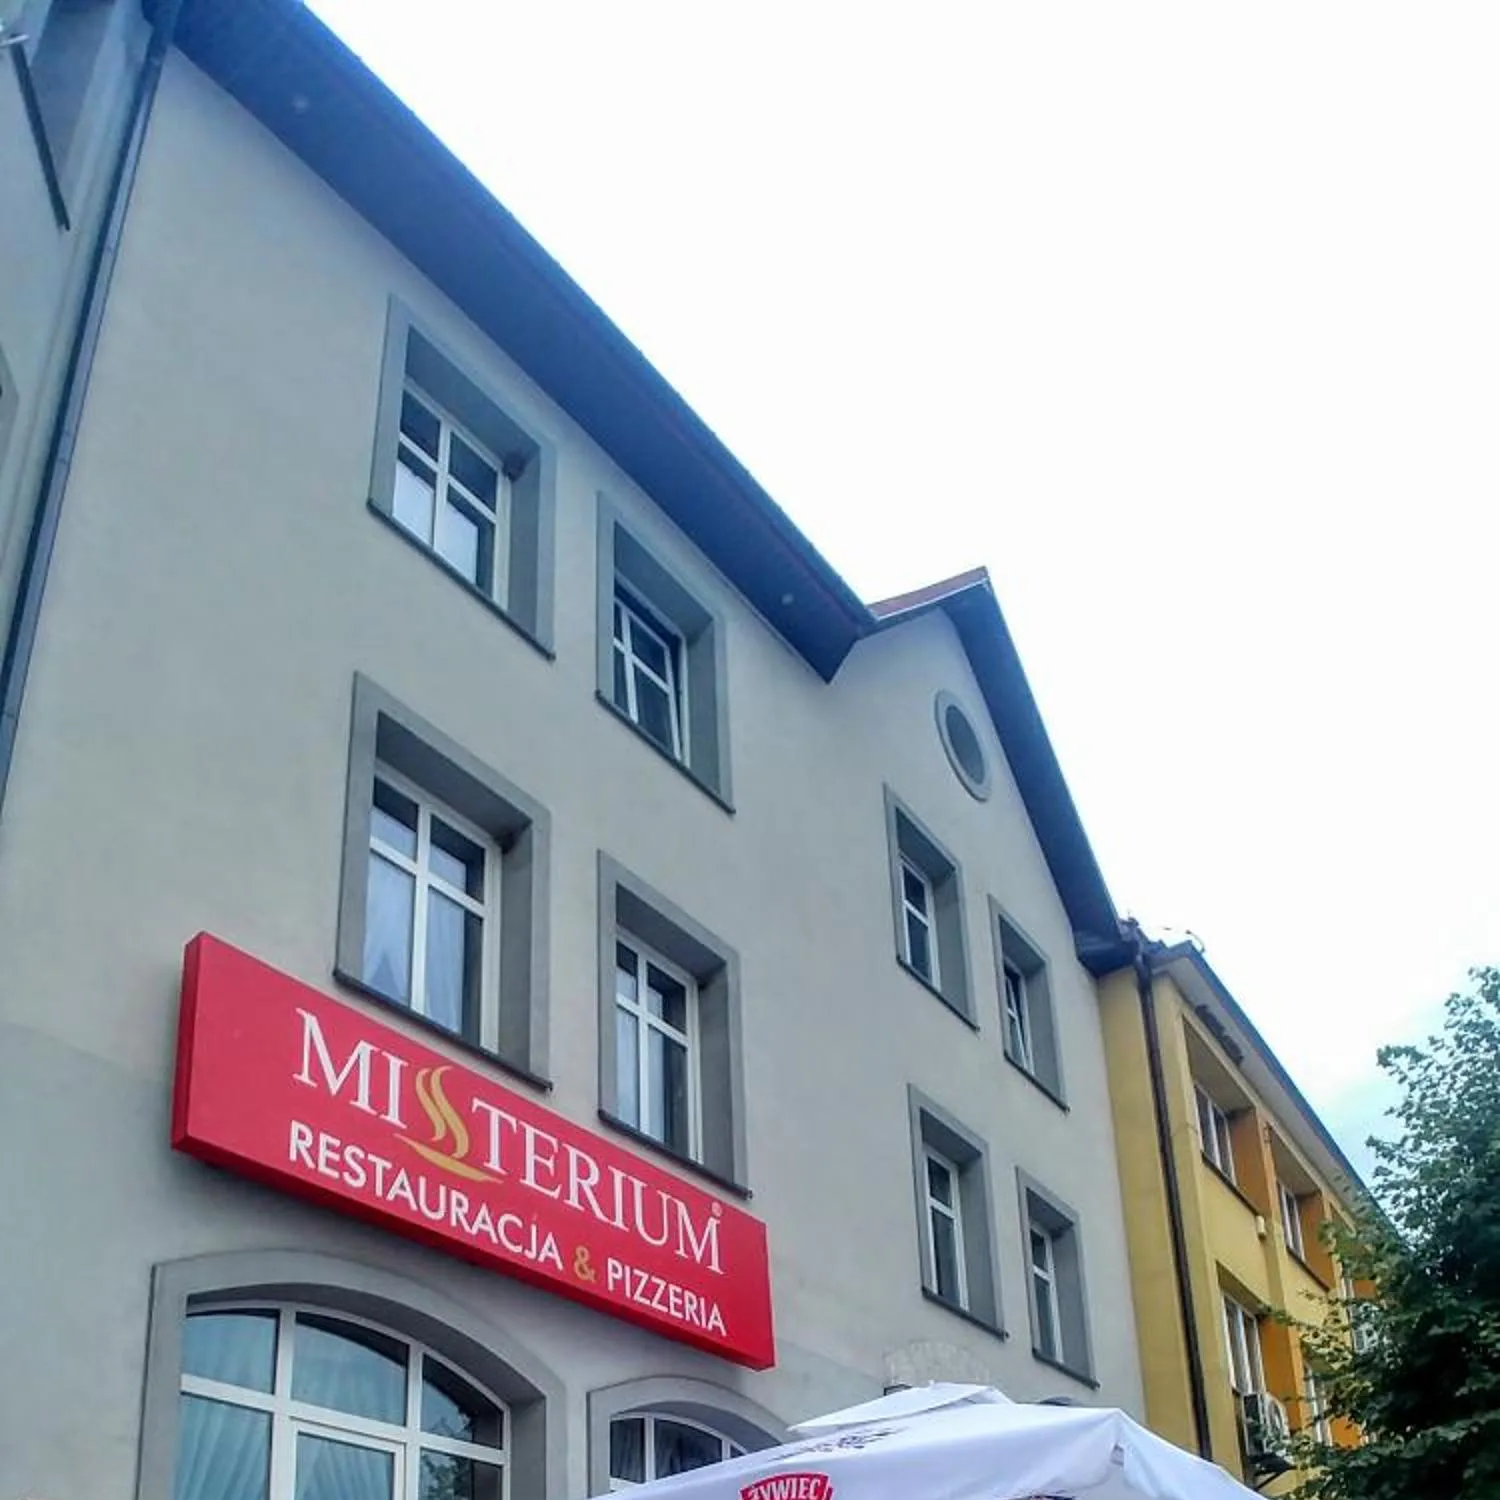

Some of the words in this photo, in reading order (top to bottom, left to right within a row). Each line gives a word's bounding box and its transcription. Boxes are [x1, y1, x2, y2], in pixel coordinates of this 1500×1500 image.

[288, 1120, 563, 1271] RESTAURACJA
[573, 1245, 596, 1282] &
[607, 1257, 727, 1337] PIZZERIA
